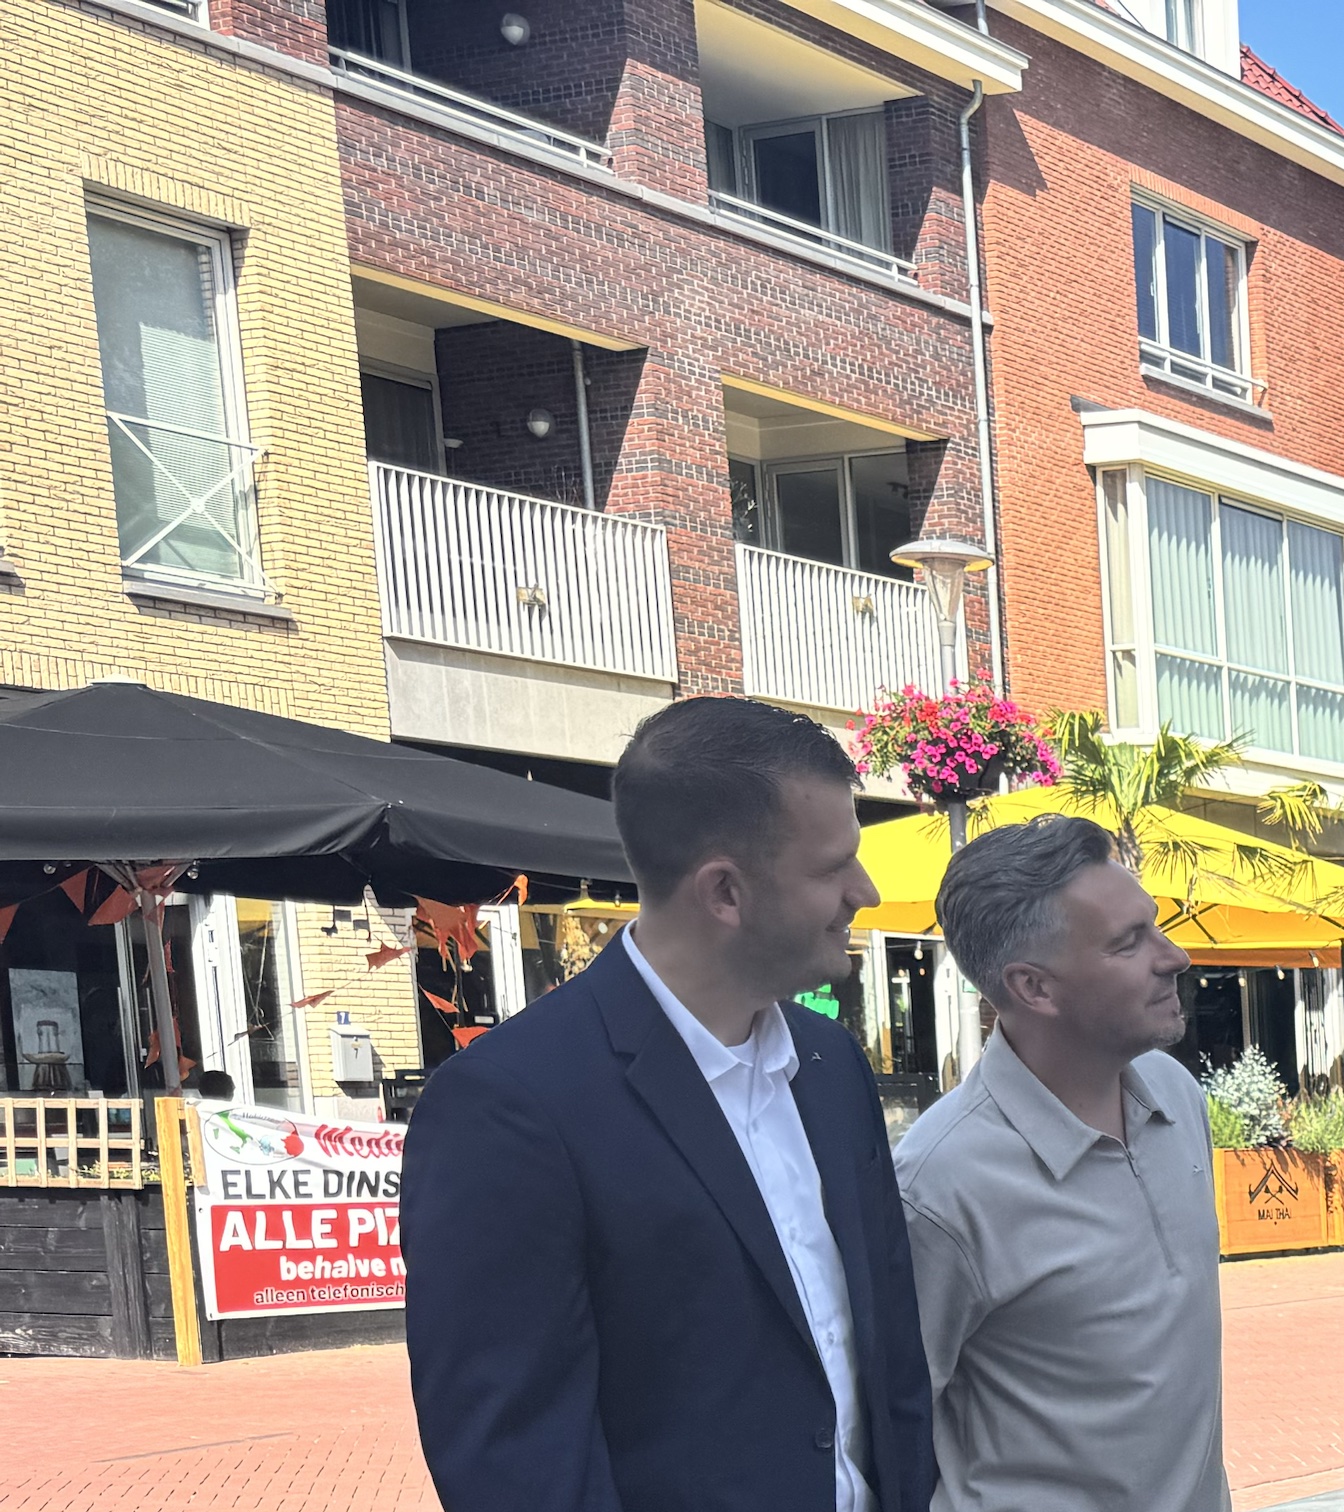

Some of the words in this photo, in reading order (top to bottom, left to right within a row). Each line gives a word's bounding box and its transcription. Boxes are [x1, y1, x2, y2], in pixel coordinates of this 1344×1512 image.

[221, 1169, 313, 1200] ELKE
[322, 1169, 401, 1199] DINS
[219, 1208, 338, 1252] ALLE
[279, 1253, 387, 1281] behalve
[254, 1286, 306, 1304] alleen
[311, 1282, 405, 1300] telefonisch
